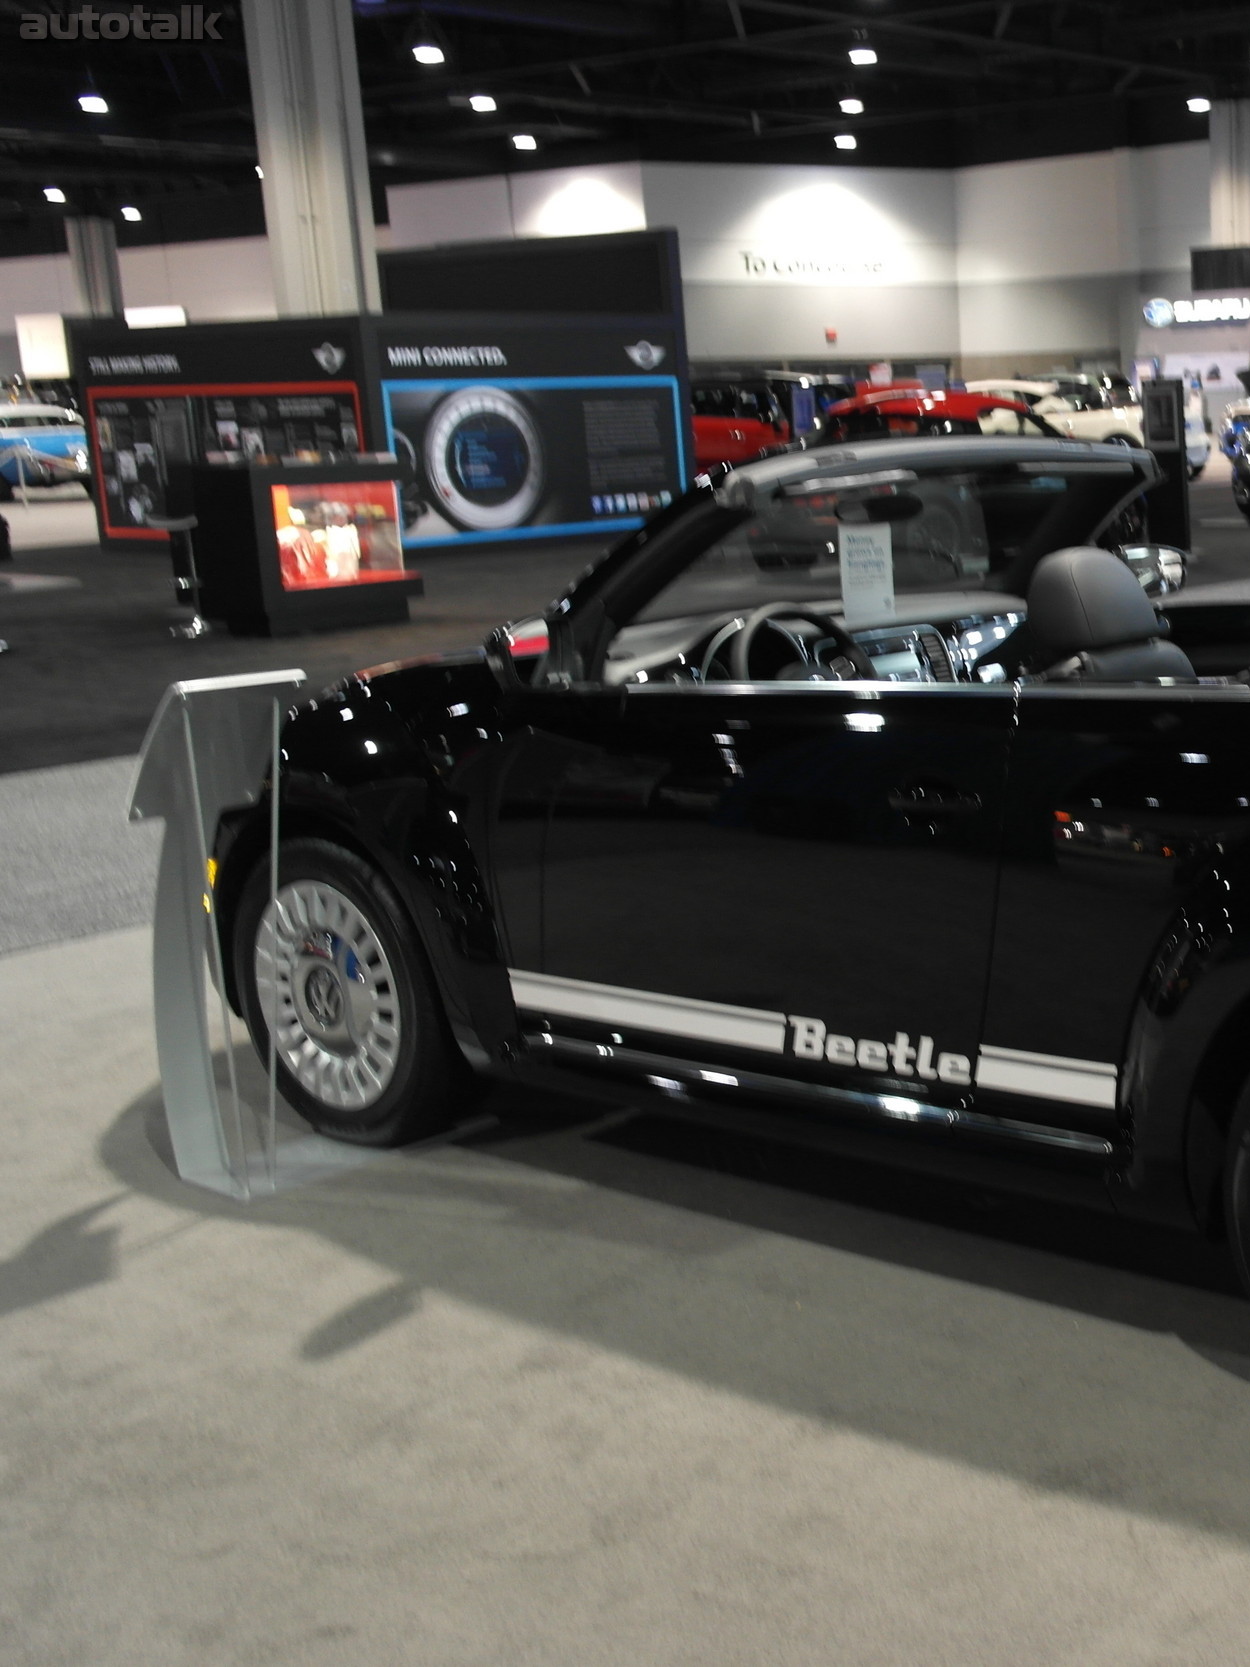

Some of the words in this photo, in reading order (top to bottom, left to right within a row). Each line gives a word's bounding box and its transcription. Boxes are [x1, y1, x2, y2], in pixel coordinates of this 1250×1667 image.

[737, 249, 766, 276] To
[387, 346, 422, 367] MINI
[787, 1014, 972, 1086] Beetle
